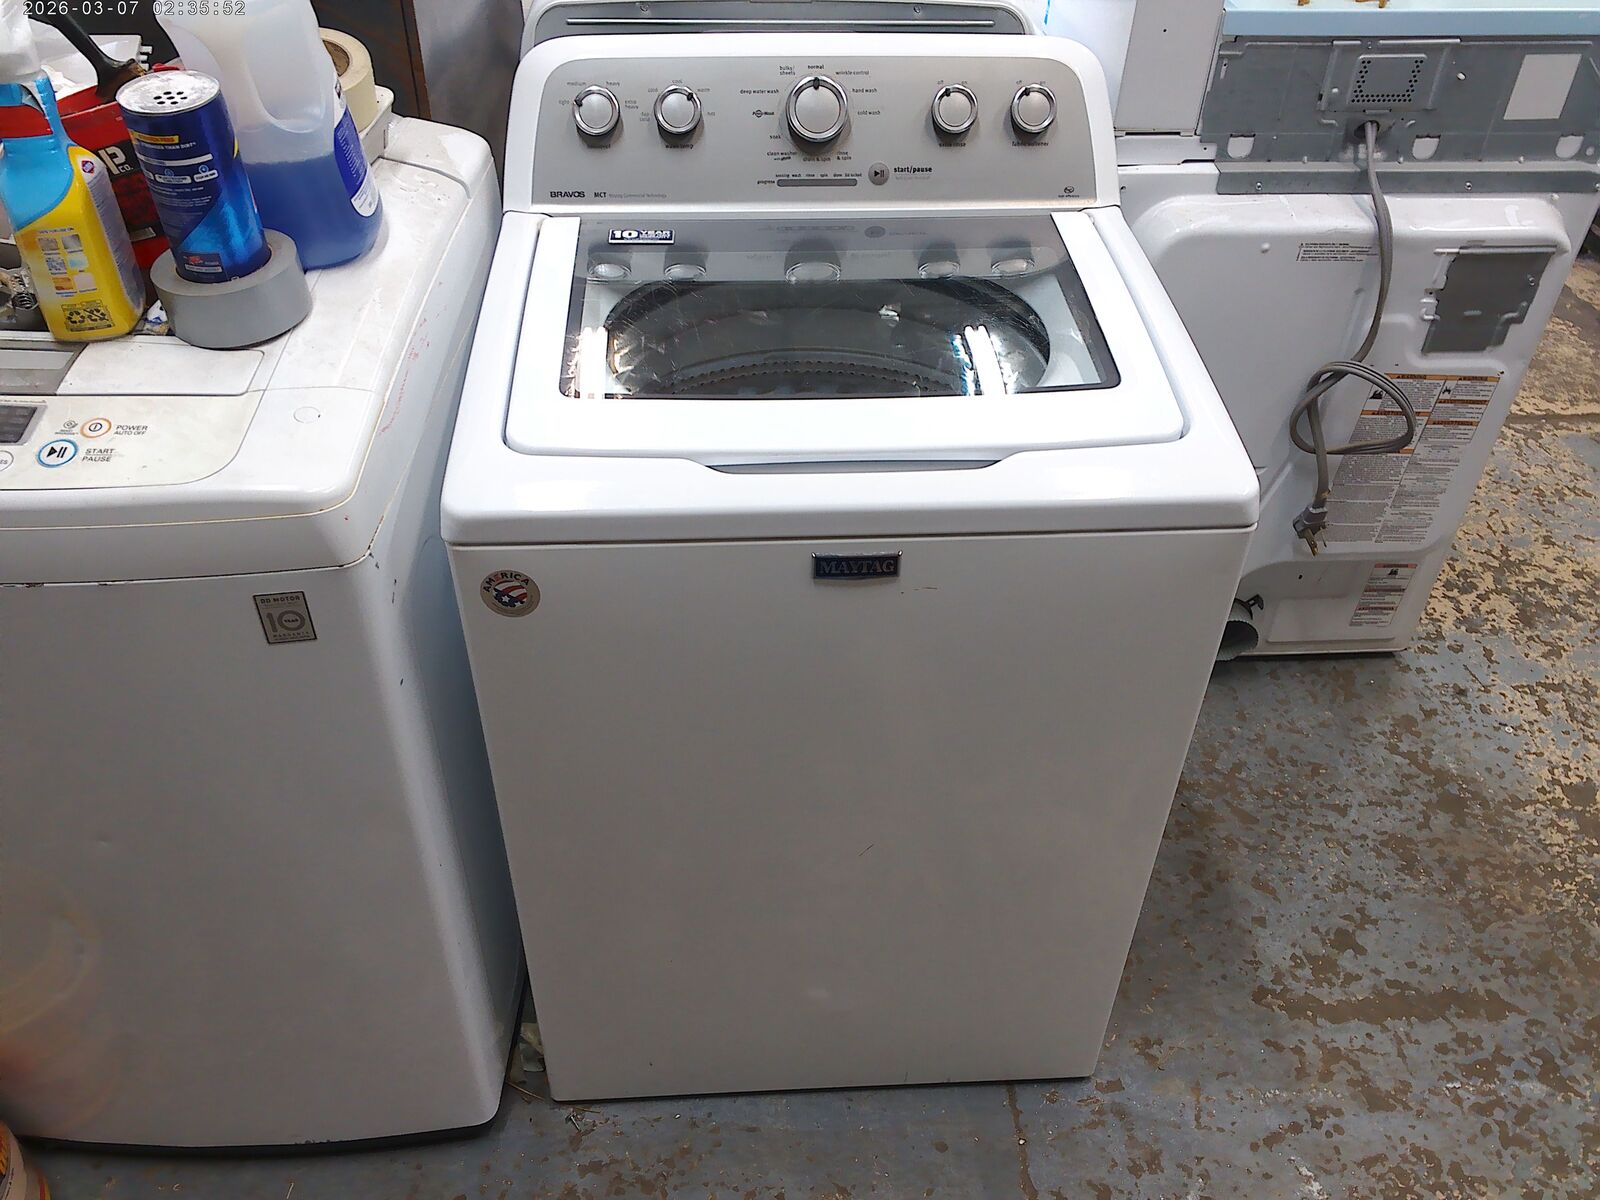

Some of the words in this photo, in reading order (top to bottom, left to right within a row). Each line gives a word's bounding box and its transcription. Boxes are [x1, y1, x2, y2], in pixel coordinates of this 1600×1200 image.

[118, 164, 134, 173] CO.
[893, 165, 933, 174] start/pause
[549, 190, 586, 198] BRAVOS
[613, 229, 639, 239] 10
[820, 560, 895, 574] MAYTAG
[482, 572, 530, 593] AMERICA
[272, 595, 301, 603] MOTOR
[265, 610, 306, 633] 10
